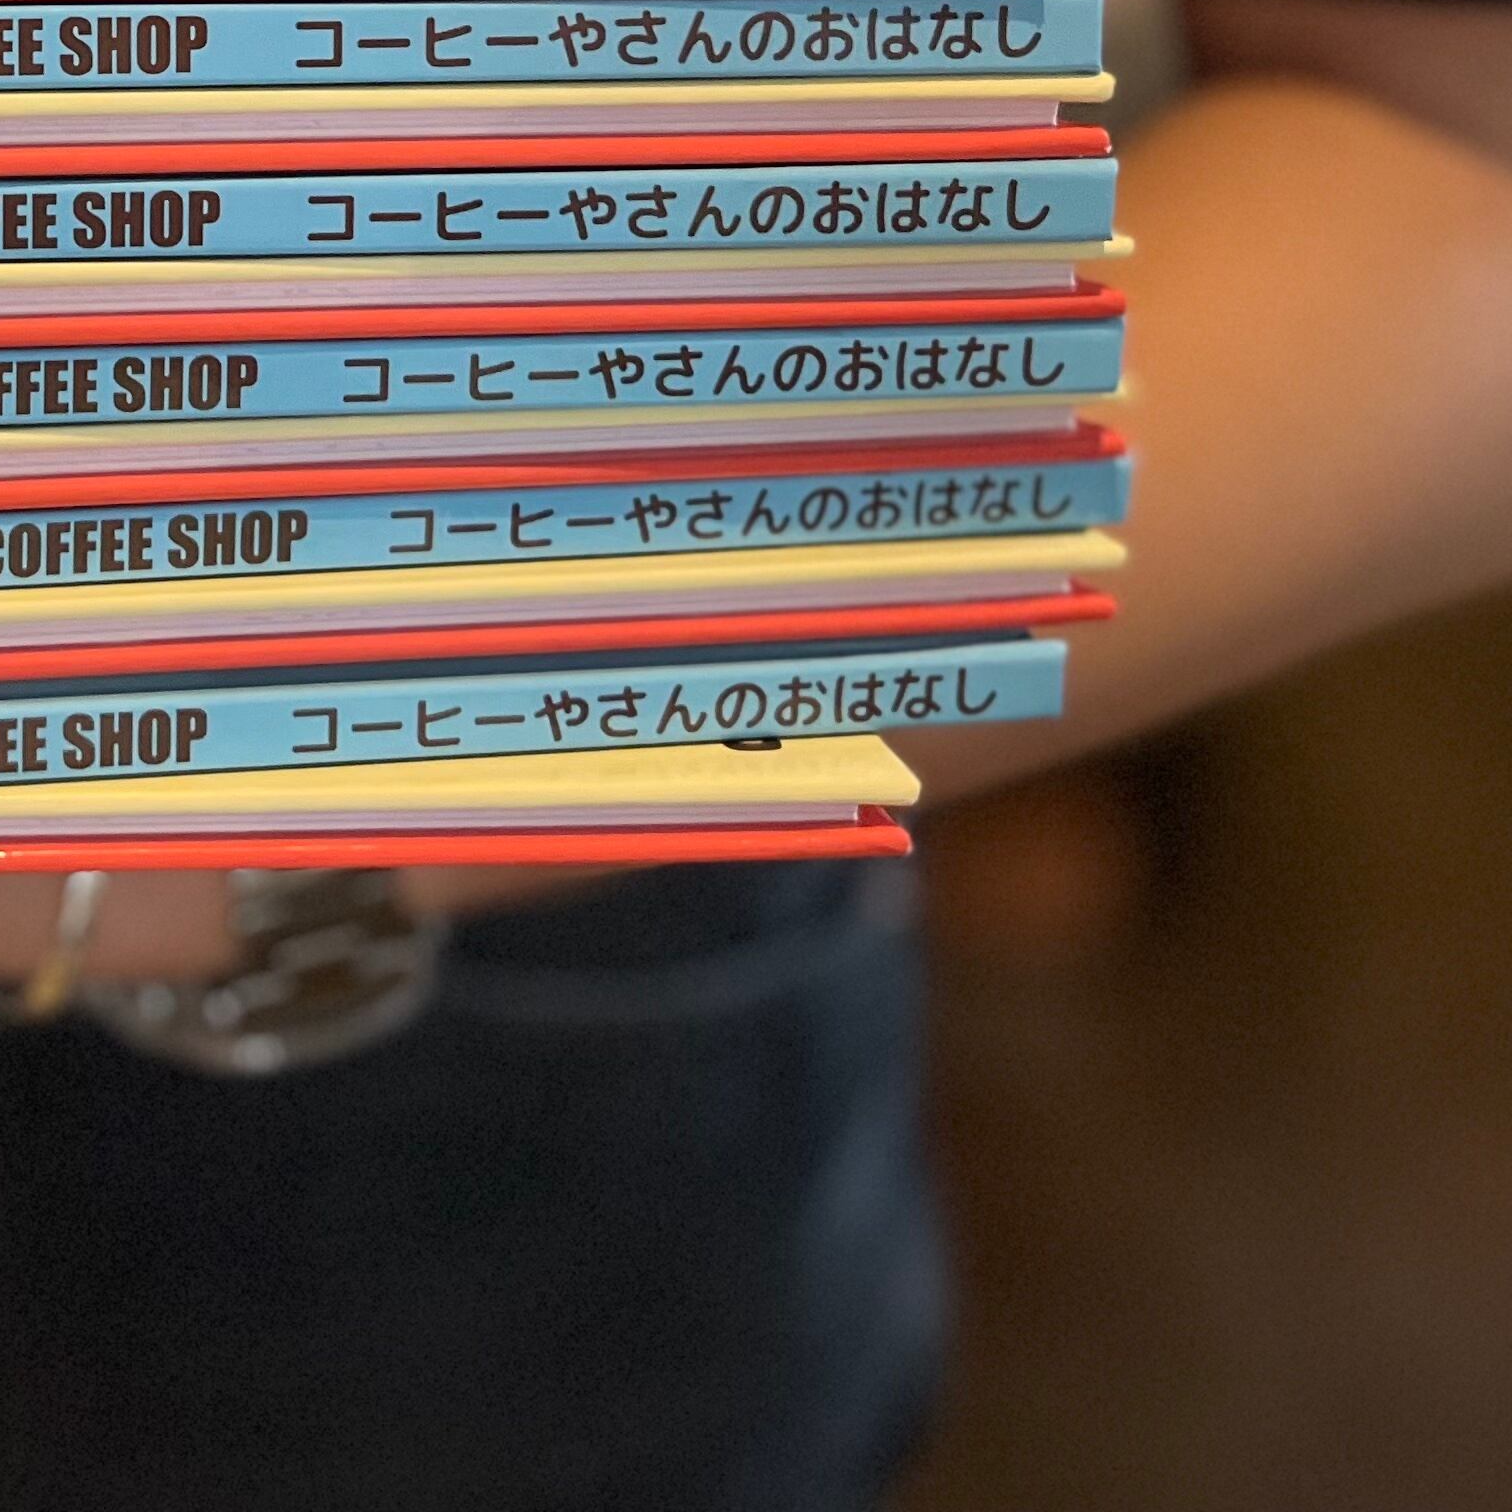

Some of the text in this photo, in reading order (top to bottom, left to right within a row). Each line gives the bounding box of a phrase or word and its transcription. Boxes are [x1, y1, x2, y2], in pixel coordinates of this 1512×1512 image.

[60, 15, 209, 77] SHOP
[296, 3, 1042, 69] コーヒーやさんのおはなし
[73, 190, 221, 250] SHOP
[307, 178, 1051, 243] コーヒーやさんのおはなし
[113, 354, 259, 414] SHOP
[344, 335, 1066, 403] コーヒーやさんのおはなし
[168, 509, 309, 570] SHOP
[390, 472, 1072, 554] コーヒーやさんのおはなし
[63, 708, 208, 771] SHOP
[293, 667, 998, 754] コーヒーやさんのおはなし
